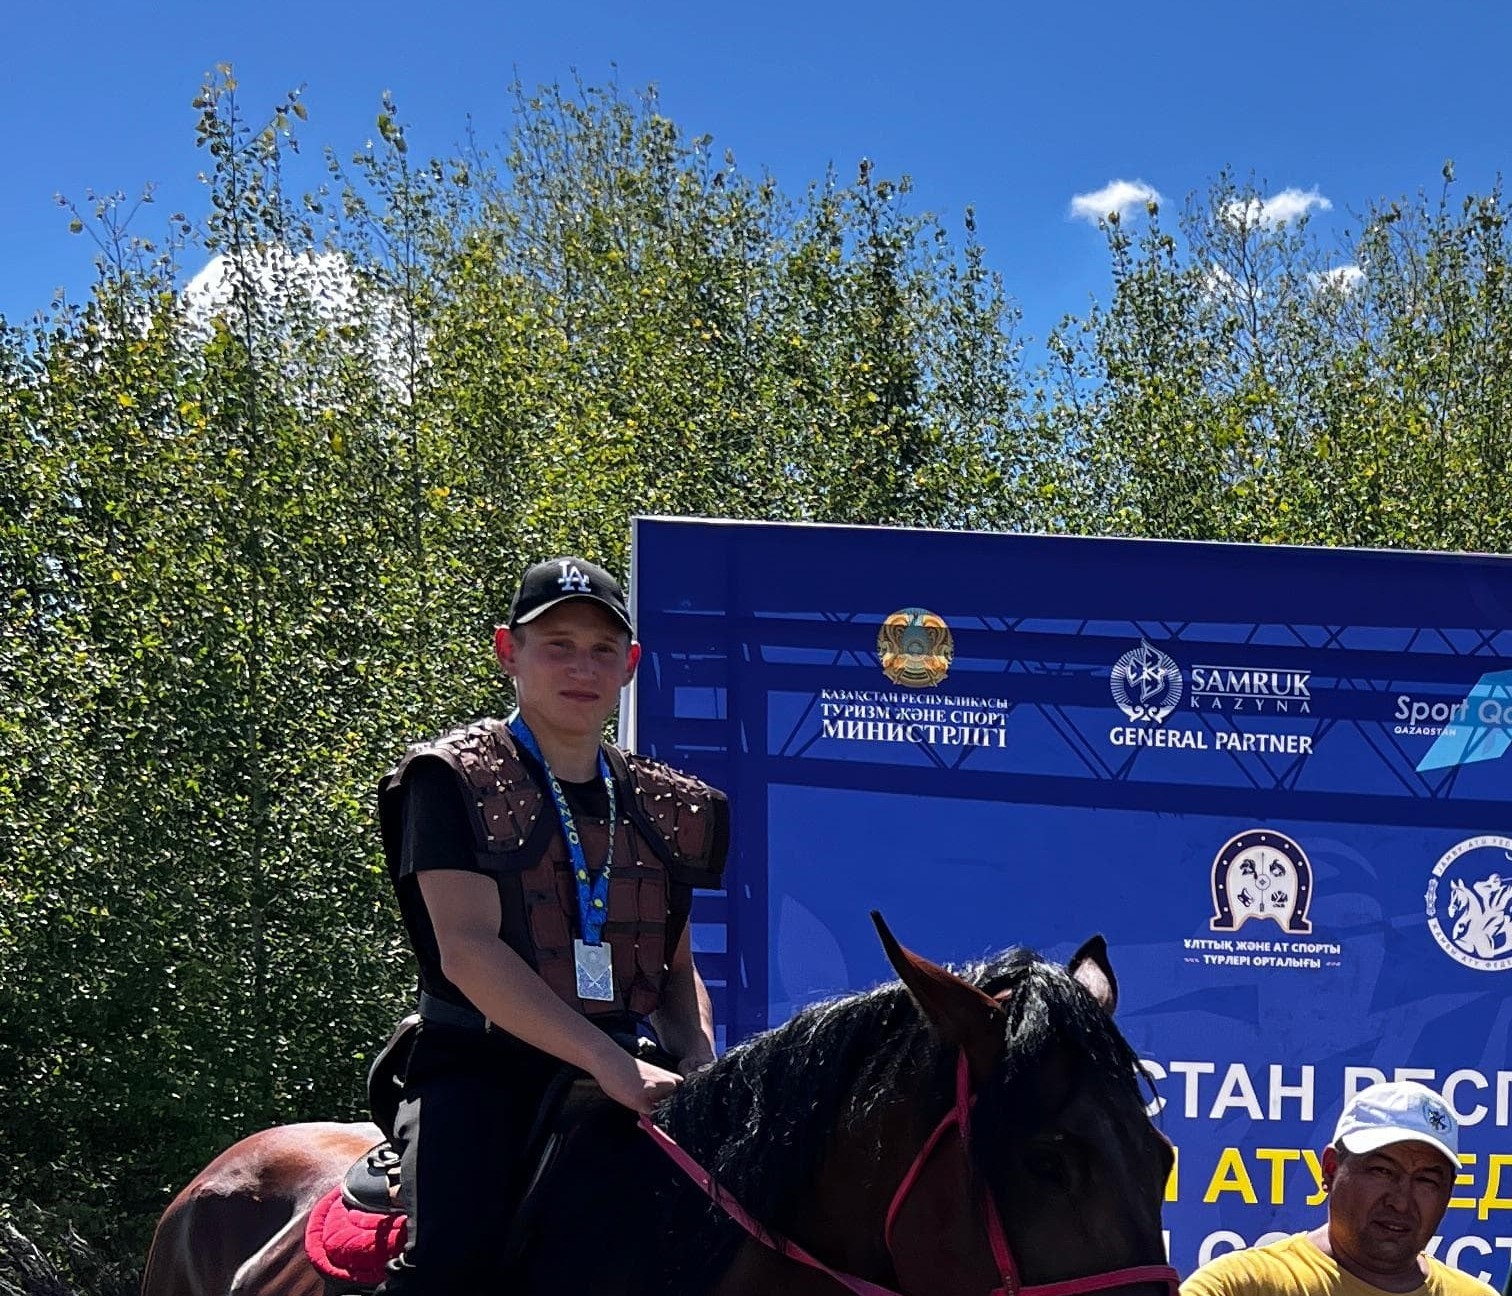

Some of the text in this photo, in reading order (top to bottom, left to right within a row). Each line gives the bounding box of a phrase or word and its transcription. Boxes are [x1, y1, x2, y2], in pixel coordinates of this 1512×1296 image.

[557, 560, 592, 593] LA
[1191, 668, 1311, 696] SAMRUK
[821, 689, 1009, 709] ҚАЗАҚСТАН РЕСПУБЛИКАСЫ
[1190, 696, 1311, 713] KAZYNA
[1394, 695, 1469, 725] Sport
[820, 703, 1009, 726] ТУРИЗМ ЖӘНЕ СПОРТ
[821, 719, 1007, 748] МИНИСТРЛІГІ
[1109, 726, 1313, 754] GENERAL PARTNER
[1393, 725, 1456, 736] QAZAQSTAN
[1183, 938, 1341, 954] ҰЛТТЫҚ ЖӘНЕ АТ СПОРТЫ
[1202, 954, 1321, 968] ТҮРЛЕРІ ОРТАЛЫҒЫ
[1136, 1059, 1315, 1121] СТАН
